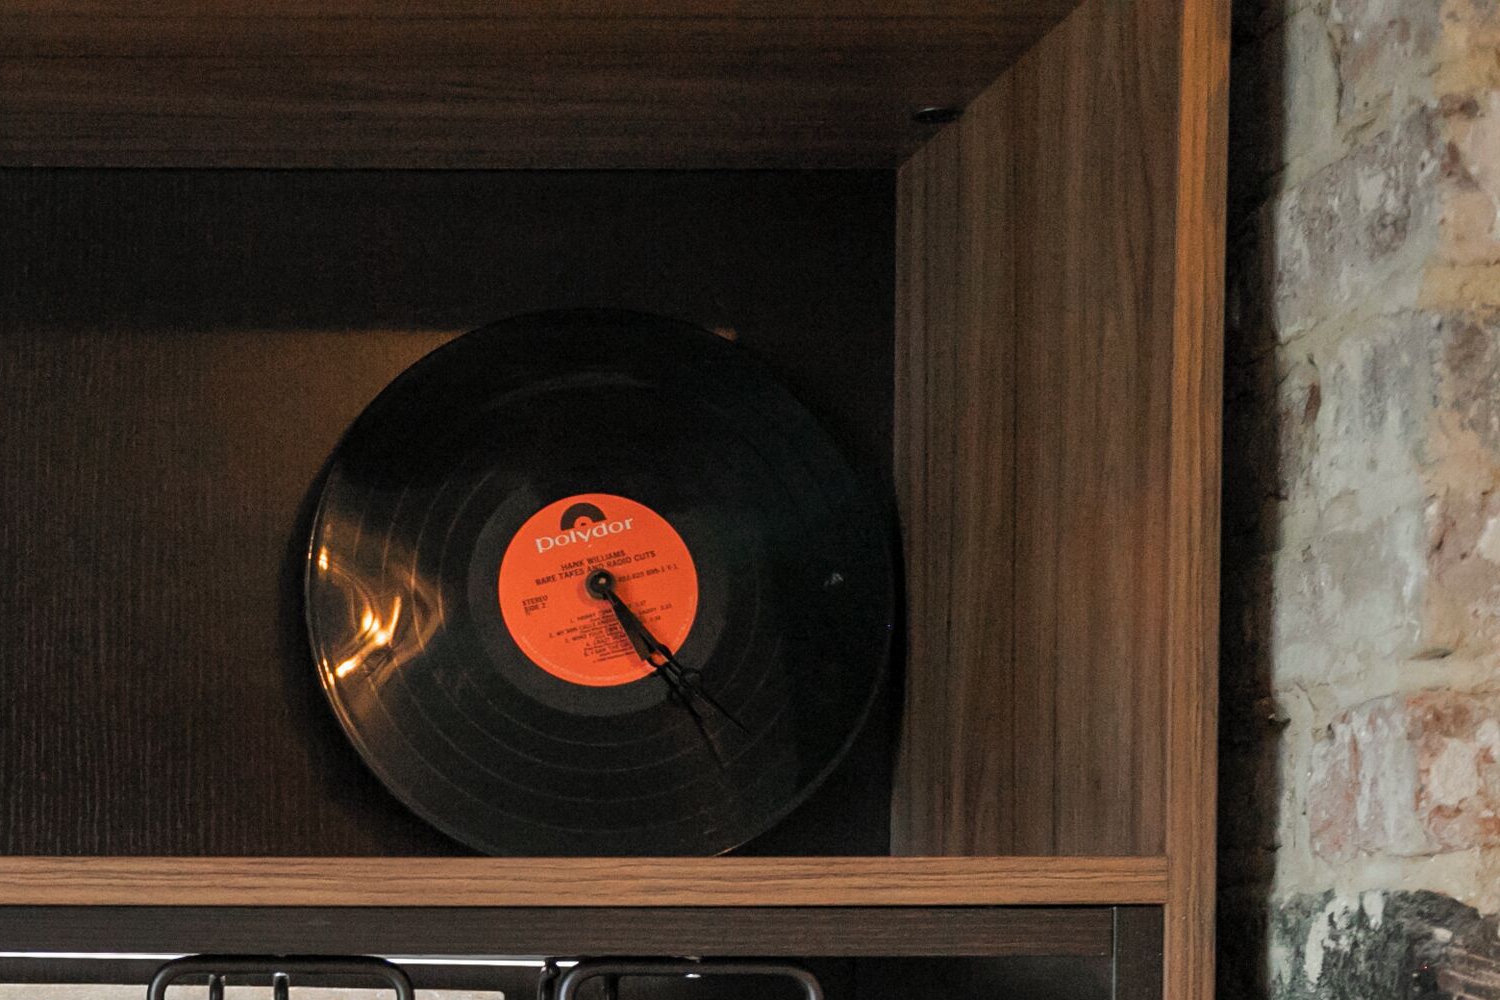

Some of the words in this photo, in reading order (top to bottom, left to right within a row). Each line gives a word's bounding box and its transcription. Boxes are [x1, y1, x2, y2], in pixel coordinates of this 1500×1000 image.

[558, 568, 585, 579] TAKES
[606, 557, 633, 567] RADIO
[633, 551, 656, 561] CUTS
[586, 550, 626, 564] WILLIAMS
